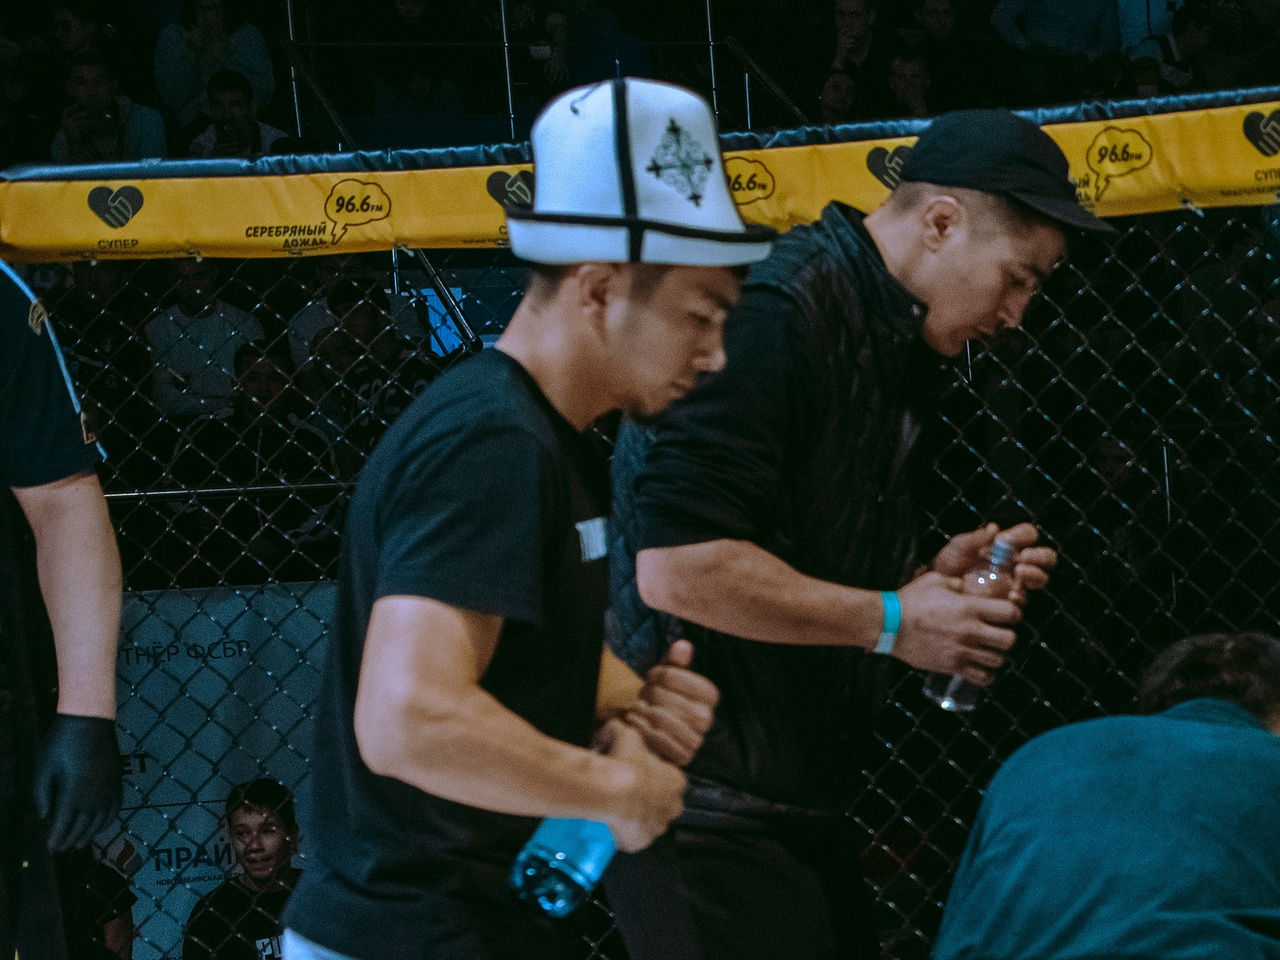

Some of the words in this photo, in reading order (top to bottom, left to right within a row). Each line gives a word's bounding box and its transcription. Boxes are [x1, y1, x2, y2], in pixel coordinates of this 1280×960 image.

[245, 221, 327, 238] СЕРЕБРЯНЫЙ
[97, 239, 139, 249] СУПЕР
[282, 238, 328, 249] ДОЖДЬ
[118, 641, 180, 666] ТНЁР
